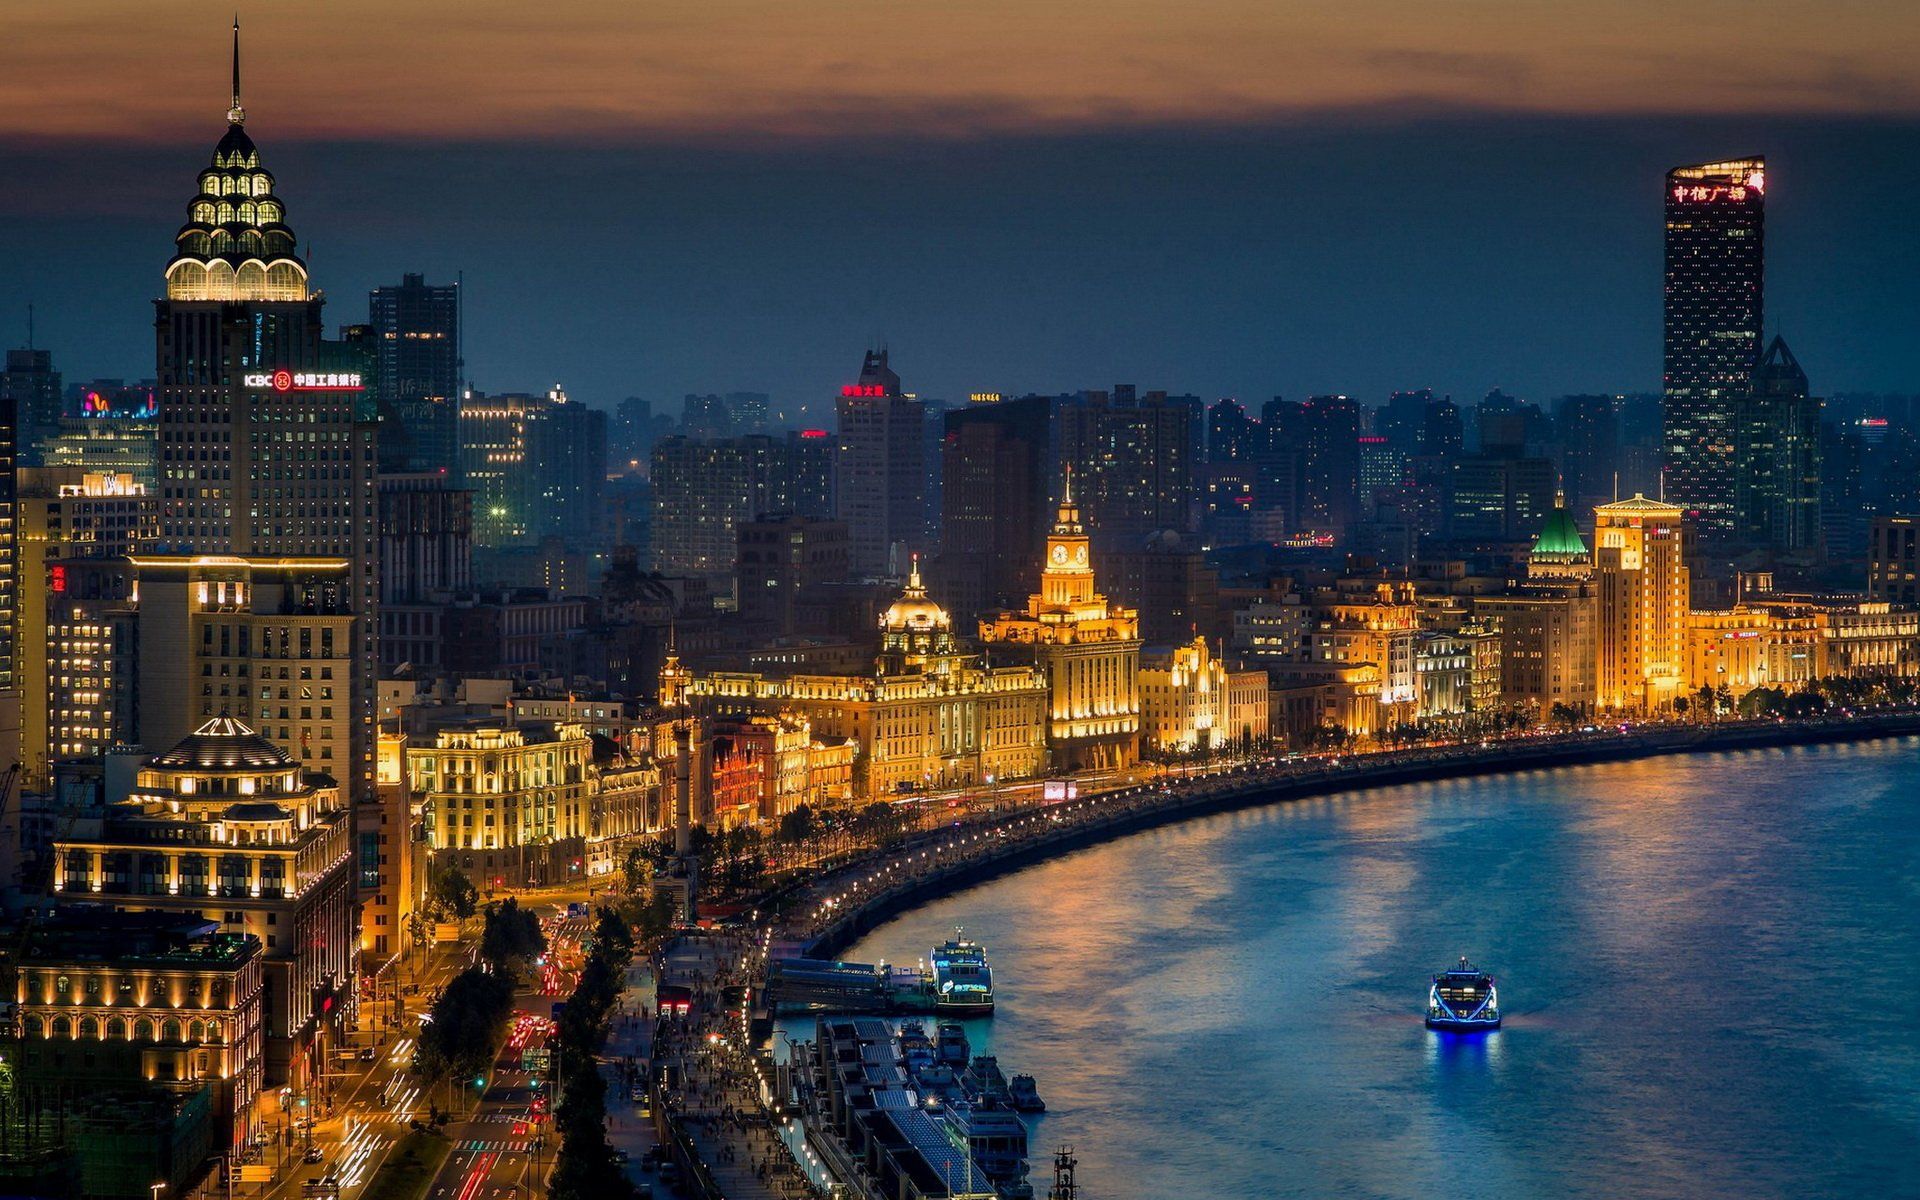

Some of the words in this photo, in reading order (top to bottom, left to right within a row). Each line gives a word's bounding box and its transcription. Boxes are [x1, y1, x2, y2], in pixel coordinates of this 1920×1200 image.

[1674, 186, 1746, 202] 中信广场
[244, 375, 273, 387] ICBC
[294, 373, 361, 387] 中国工商银行
